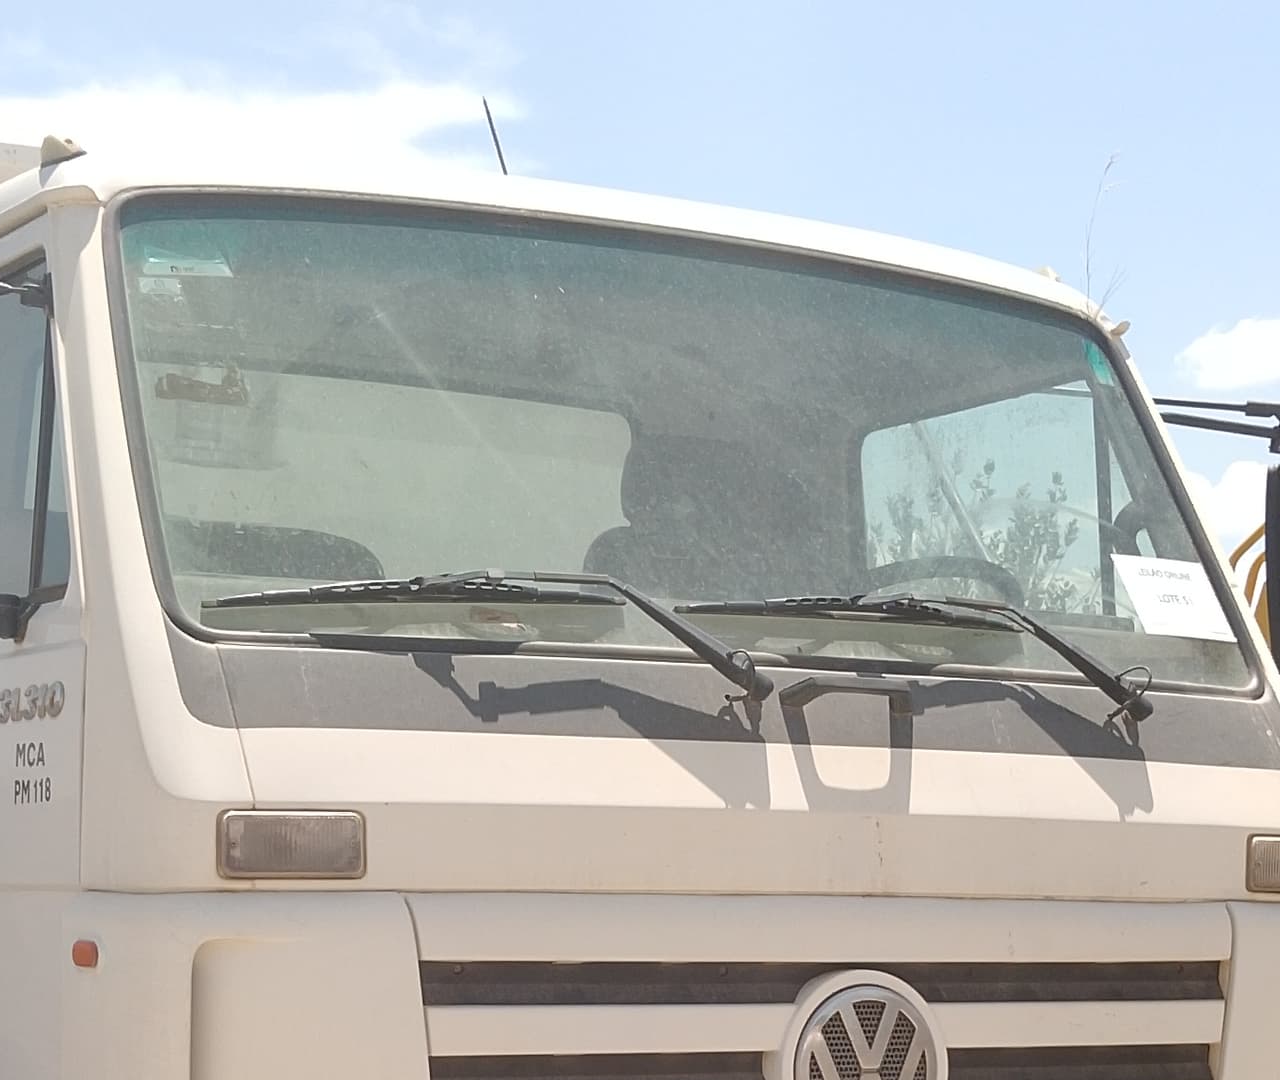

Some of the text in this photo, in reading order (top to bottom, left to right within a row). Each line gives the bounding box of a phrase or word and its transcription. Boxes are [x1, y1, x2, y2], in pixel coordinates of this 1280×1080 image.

[15, 742, 46, 768] MCA
[14, 777, 52, 805] PM 118
